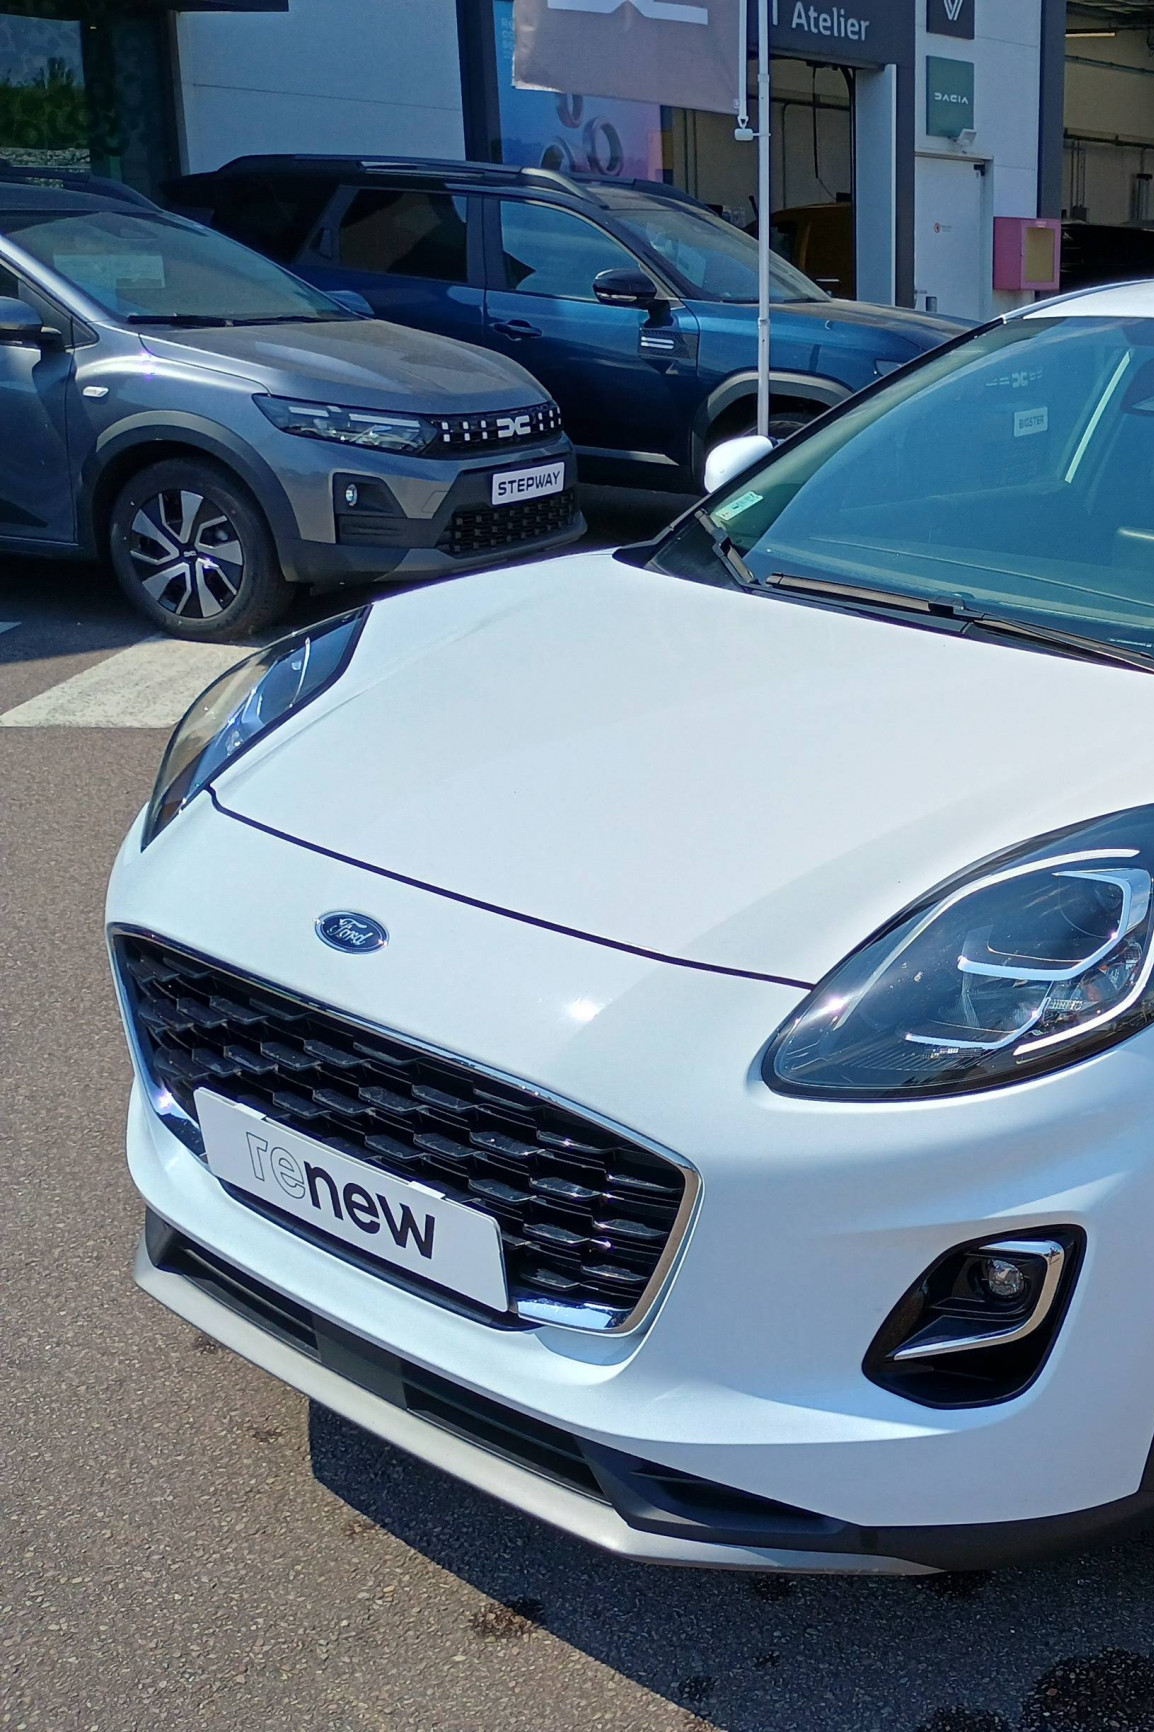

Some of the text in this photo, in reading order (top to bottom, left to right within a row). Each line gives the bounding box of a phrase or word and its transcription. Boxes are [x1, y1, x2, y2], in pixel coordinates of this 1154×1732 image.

[791, 1, 870, 41] Atelier
[934, 92, 969, 105] DACIA
[498, 471, 561, 496] STEPWAY
[327, 918, 374, 945] Ford
[246, 1131, 436, 1260] renew
